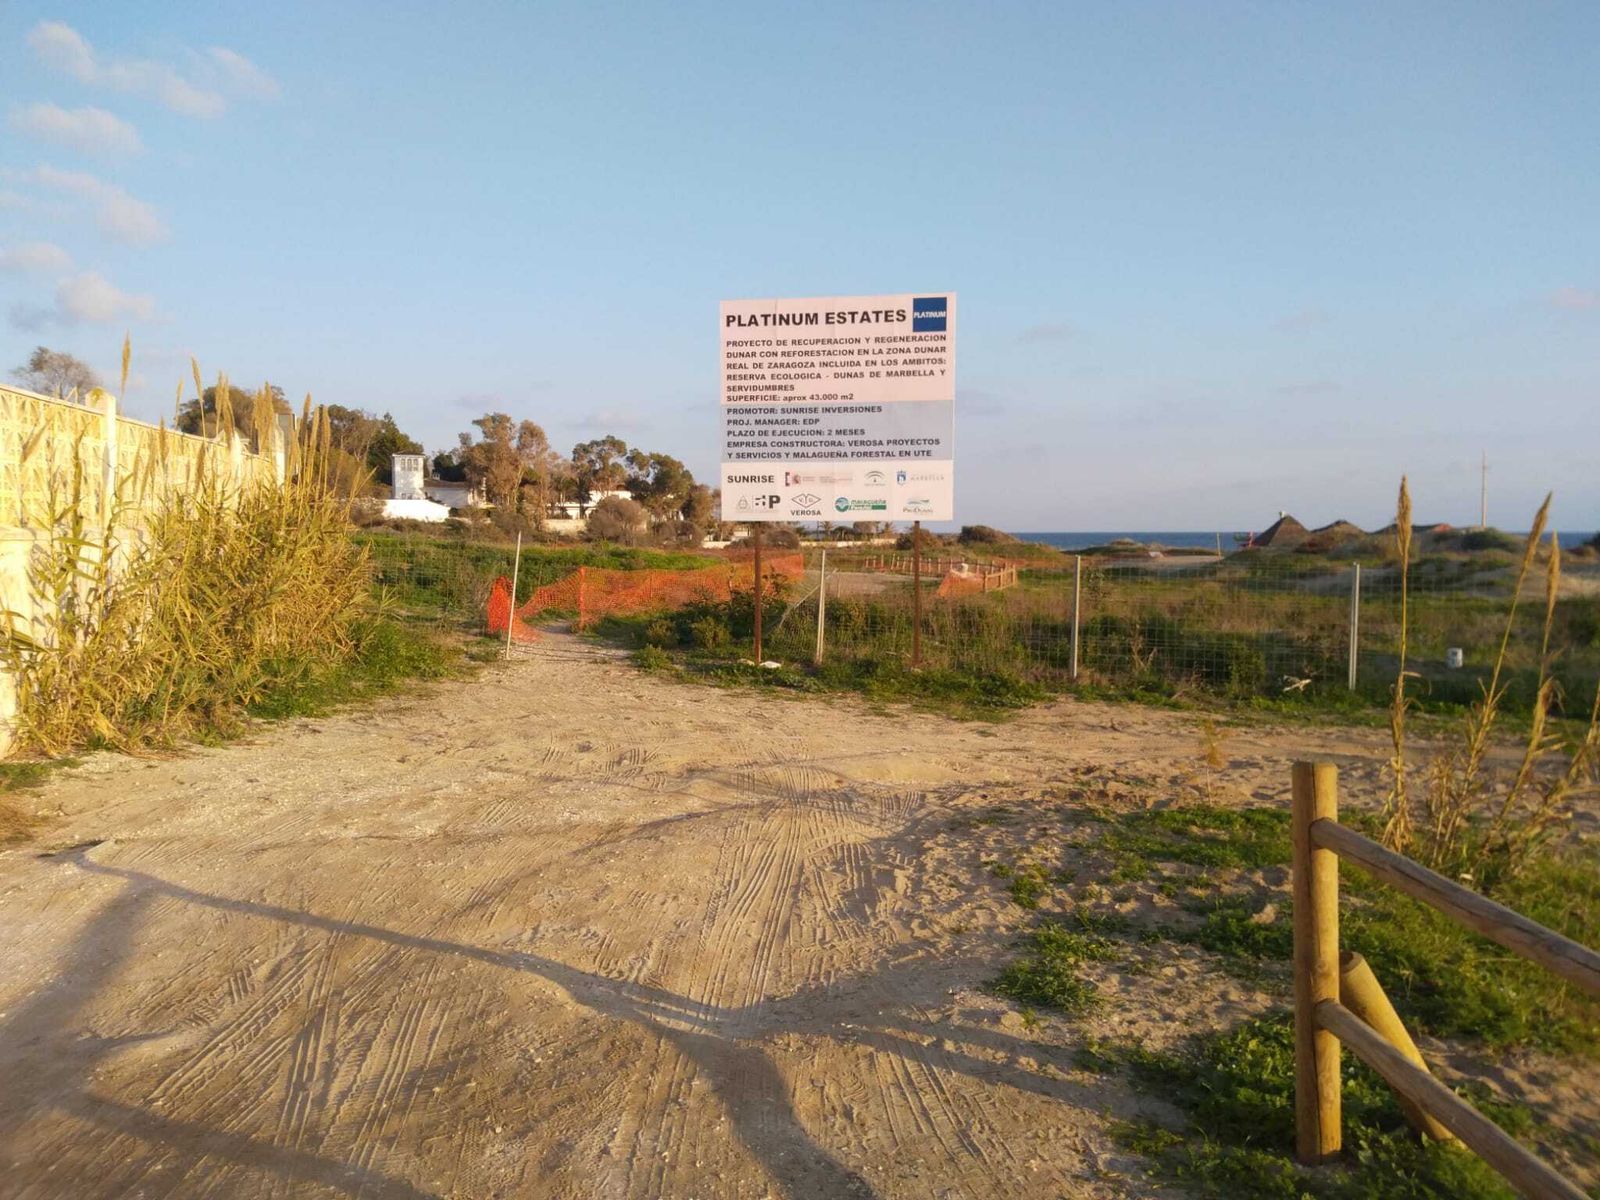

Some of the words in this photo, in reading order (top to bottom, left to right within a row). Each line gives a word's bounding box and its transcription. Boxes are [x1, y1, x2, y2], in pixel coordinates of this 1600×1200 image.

[726, 312, 819, 327] PLATINUM
[825, 310, 906, 324] ESTATES
[726, 339, 773, 347] PROYECTO
[791, 337, 861, 346] RECUPERACION
[875, 335, 946, 344] REGENERACION
[726, 351, 757, 359] DUNAR
[781, 349, 854, 357] REFORESTACION
[886, 347, 912, 355] ZONA
[914, 346, 946, 354] DUNAR
[726, 362, 748, 370] REAL
[767, 361, 815, 369] ZARAGOZA
[819, 360, 861, 368] INCLUIDA
[726, 373, 766, 381] RESERVA
[771, 372, 822, 380] ECOLOGICA
[834, 371, 865, 379] DUNAS
[886, 369, 935, 377] MARBELLA
[726, 384, 795, 392] SERVIDUMBRES
[783, 395, 807, 403] aprox
[809, 393, 838, 401] 43.000
[727, 407, 778, 415] PROMOTOR:
[822, 406, 882, 414] INVERSIONES
[727, 418, 752, 426] PROJ.
[754, 418, 800, 426] MANAGER:
[727, 429, 755, 437] PLAZO
[835, 428, 865, 436] MESES
[727, 440, 768, 448] EMPRESA
[770, 439, 845, 447] CONSTRUCTORA:
[848, 439, 883, 447] VEROSA
[886, 438, 940, 446] PROYECTOS
[736, 451, 782, 459] SERVICIOS
[792, 449, 848, 458] MALAGUEÑA
[898, 449, 911, 457] EN
[914, 449, 932, 457] UTE
[727, 475, 775, 484] SUNRISE
